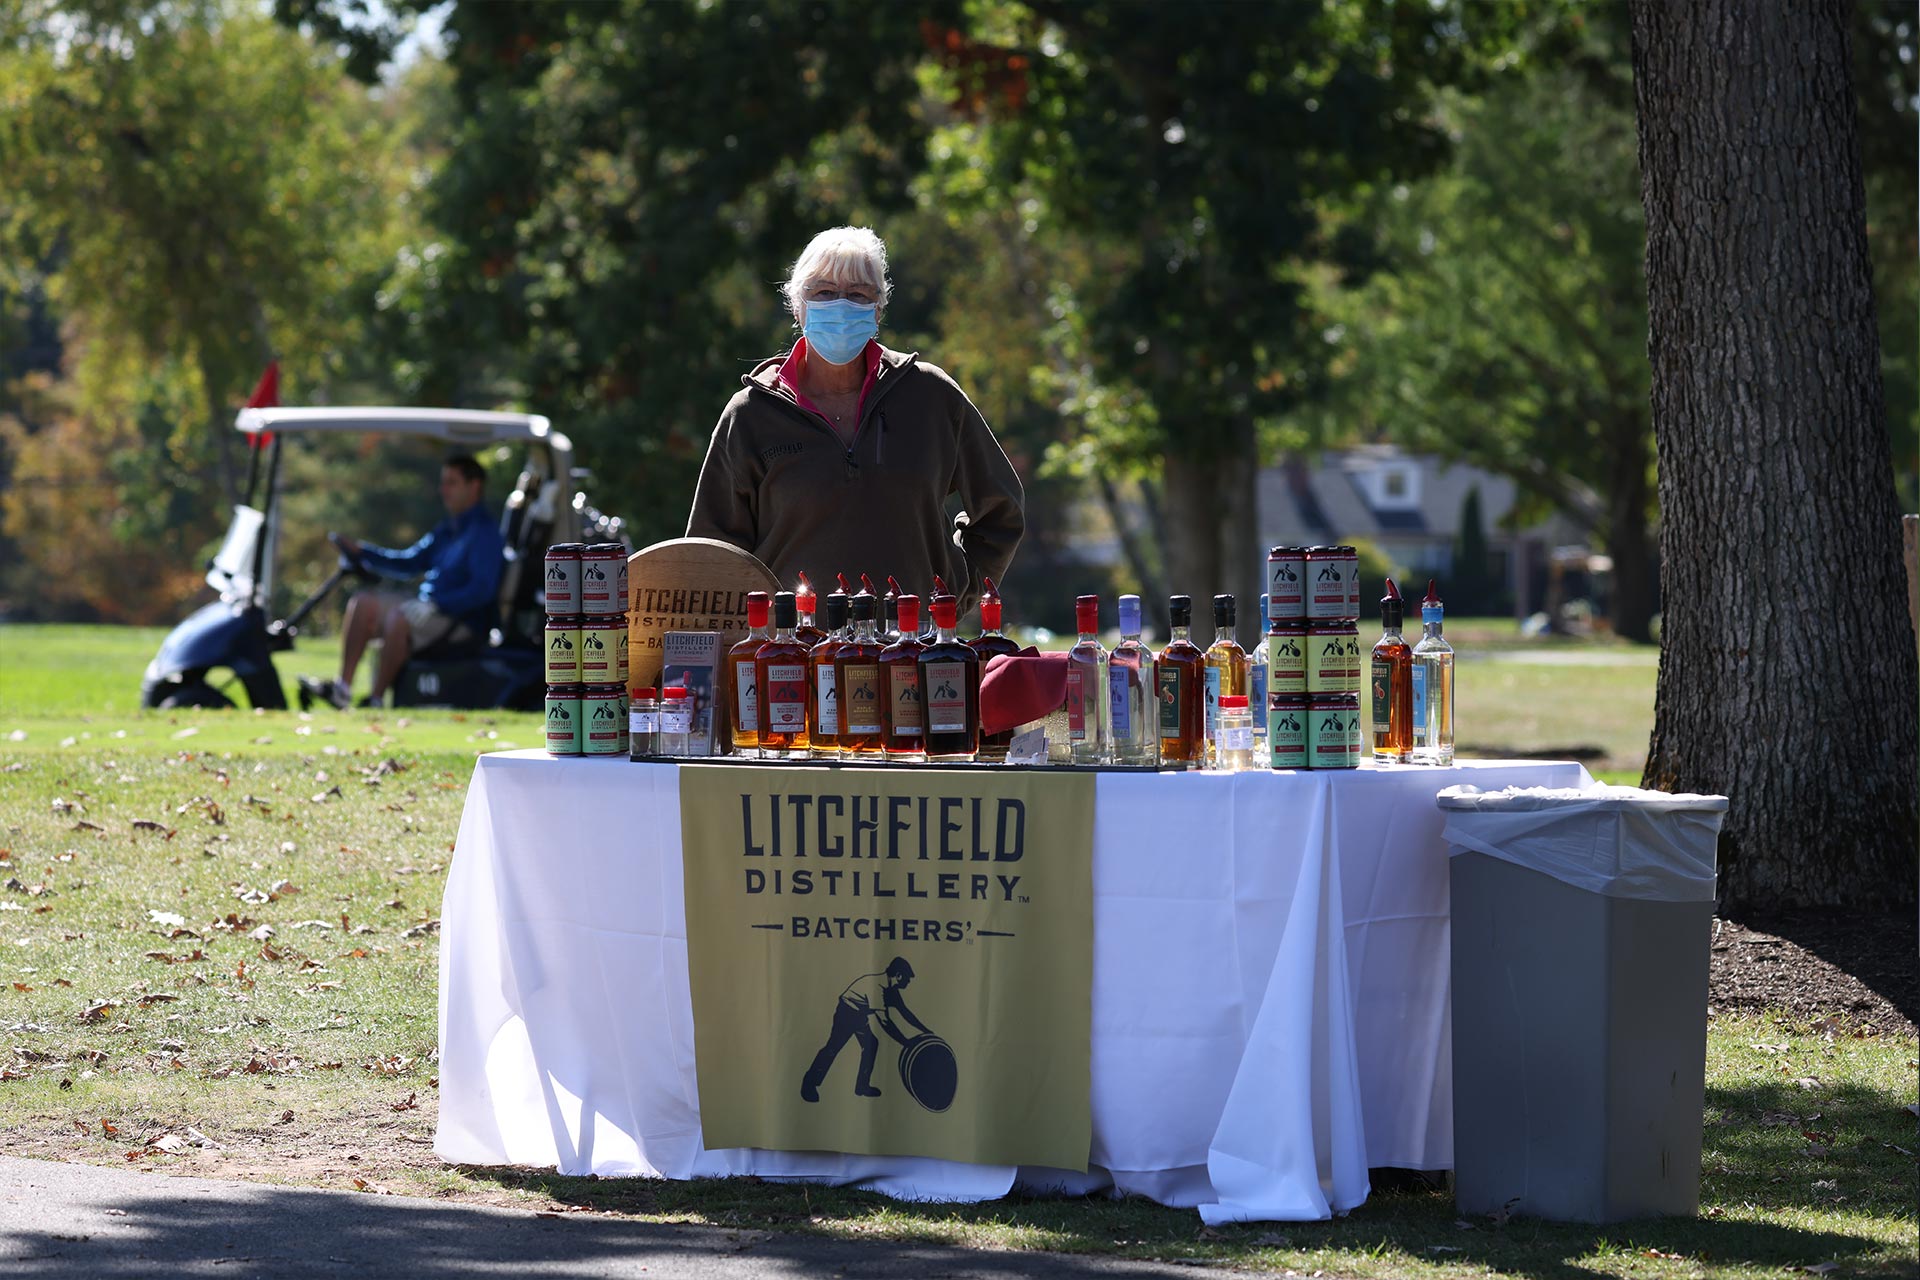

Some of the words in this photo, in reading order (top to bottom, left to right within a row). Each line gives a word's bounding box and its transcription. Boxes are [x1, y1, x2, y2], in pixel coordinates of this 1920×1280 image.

[761, 442, 803, 462] ITCHFIELD
[634, 588, 748, 616] ITCHFIELD
[667, 635, 714, 645] LITCHFIELD
[771, 669, 802, 677] LITCHFIELD
[848, 669, 879, 677] LITCHFIELD
[740, 793, 1026, 862] LITCHFIELD
[745, 868, 1021, 901] DISTILLERY
[791, 916, 973, 942] BATCHERS'
